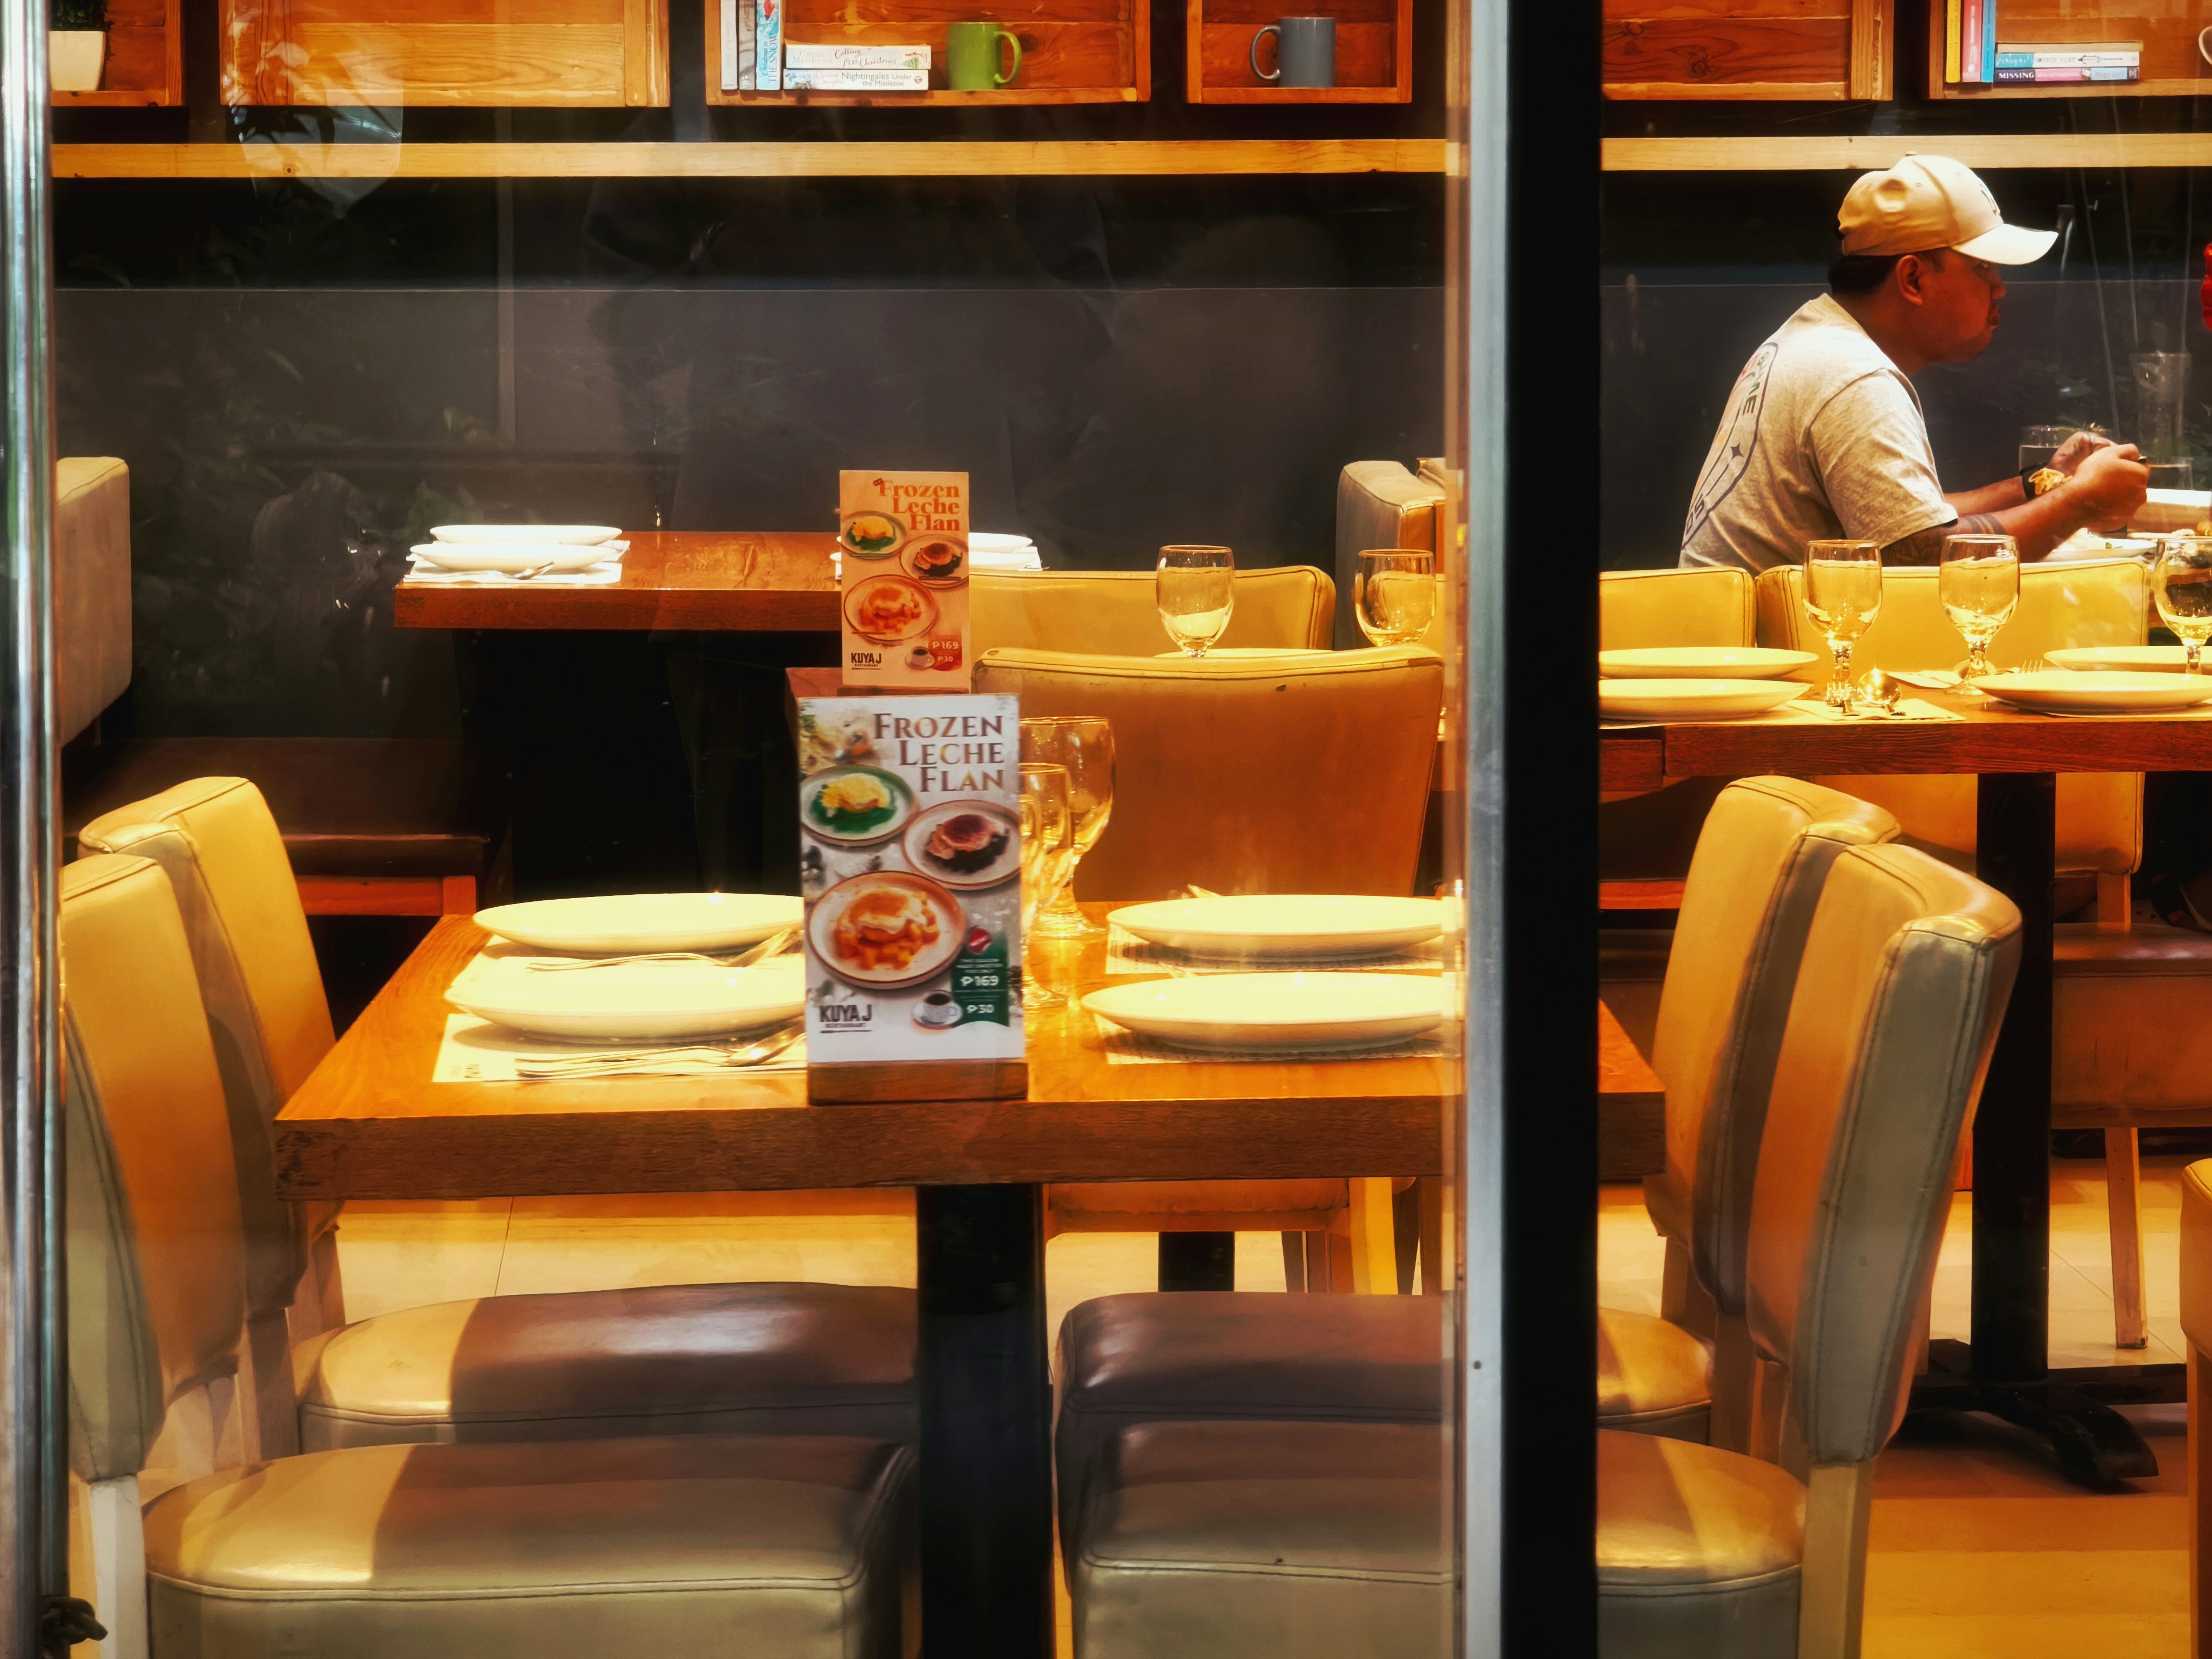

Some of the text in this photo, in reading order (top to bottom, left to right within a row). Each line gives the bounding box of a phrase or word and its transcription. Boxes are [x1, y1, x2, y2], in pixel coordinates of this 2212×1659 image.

[768, 35, 777, 84] THE SNOW
[860, 57, 896, 67] Christmas
[841, 72, 889, 82] Nightingales
[1999, 71, 2034, 79] MISSING
[879, 479, 960, 498] Frozen
[892, 497, 960, 515] Leche
[909, 514, 961, 531] Flan
[873, 713, 1003, 739] FROZEN
[899, 739, 1004, 766] LECHE
[919, 766, 1004, 792] FLAN
